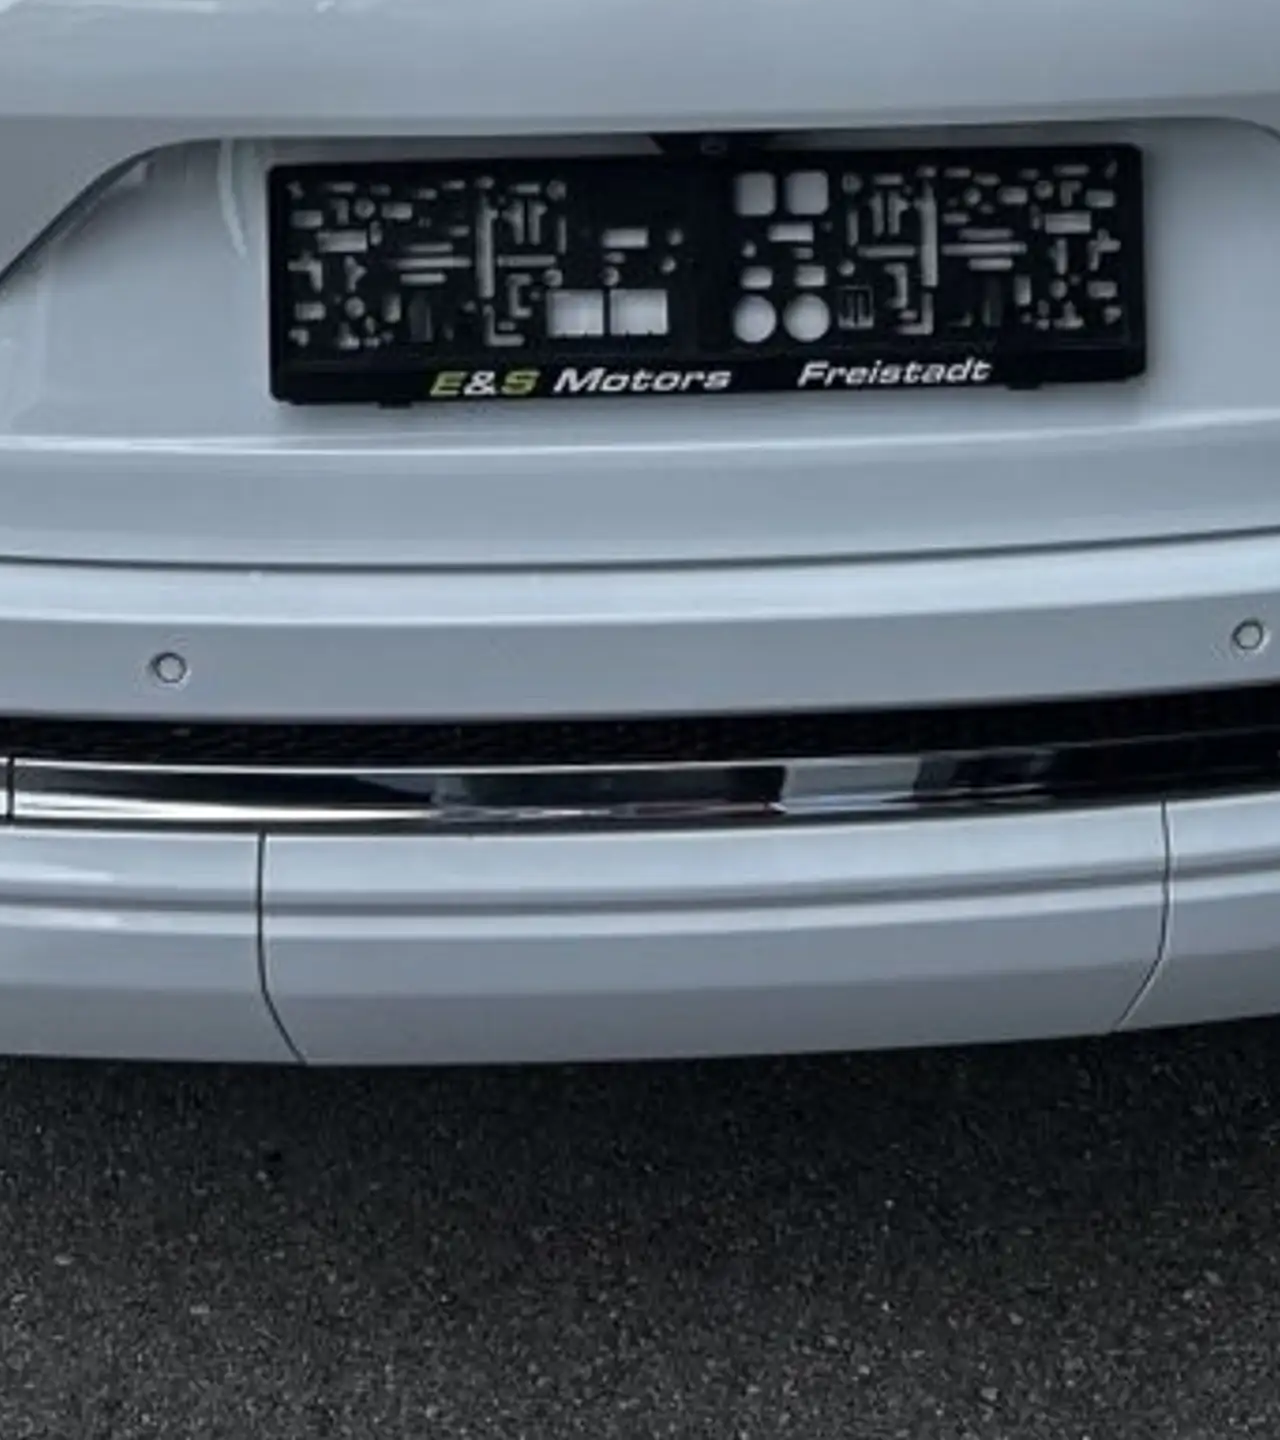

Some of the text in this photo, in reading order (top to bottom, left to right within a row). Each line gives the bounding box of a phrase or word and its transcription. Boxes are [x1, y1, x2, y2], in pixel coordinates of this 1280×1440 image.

[430, 357, 993, 397] E&S Motors Freistadt
